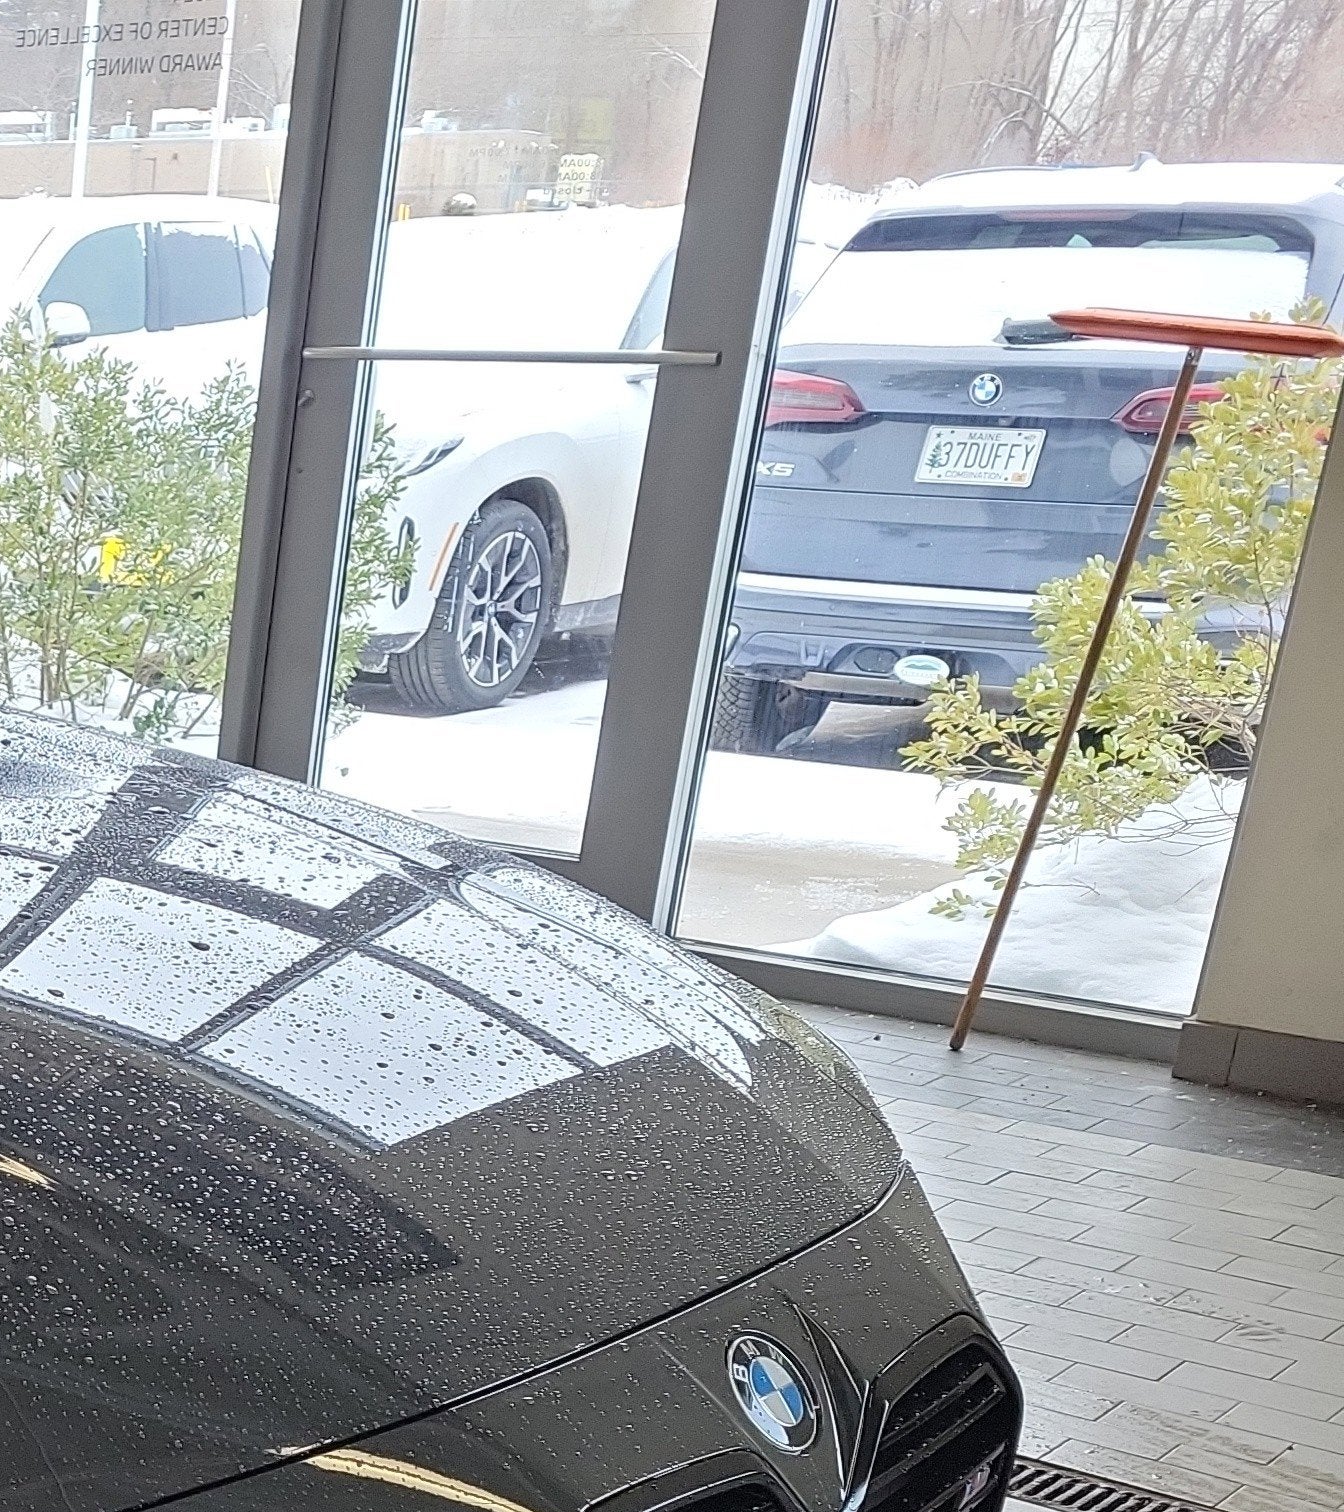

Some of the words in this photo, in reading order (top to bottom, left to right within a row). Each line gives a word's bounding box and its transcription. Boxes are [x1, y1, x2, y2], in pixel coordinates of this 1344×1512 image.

[967, 432, 1003, 441] MAINE
[940, 441, 1035, 471] 37DUFFY
[757, 460, 795, 477] X5
